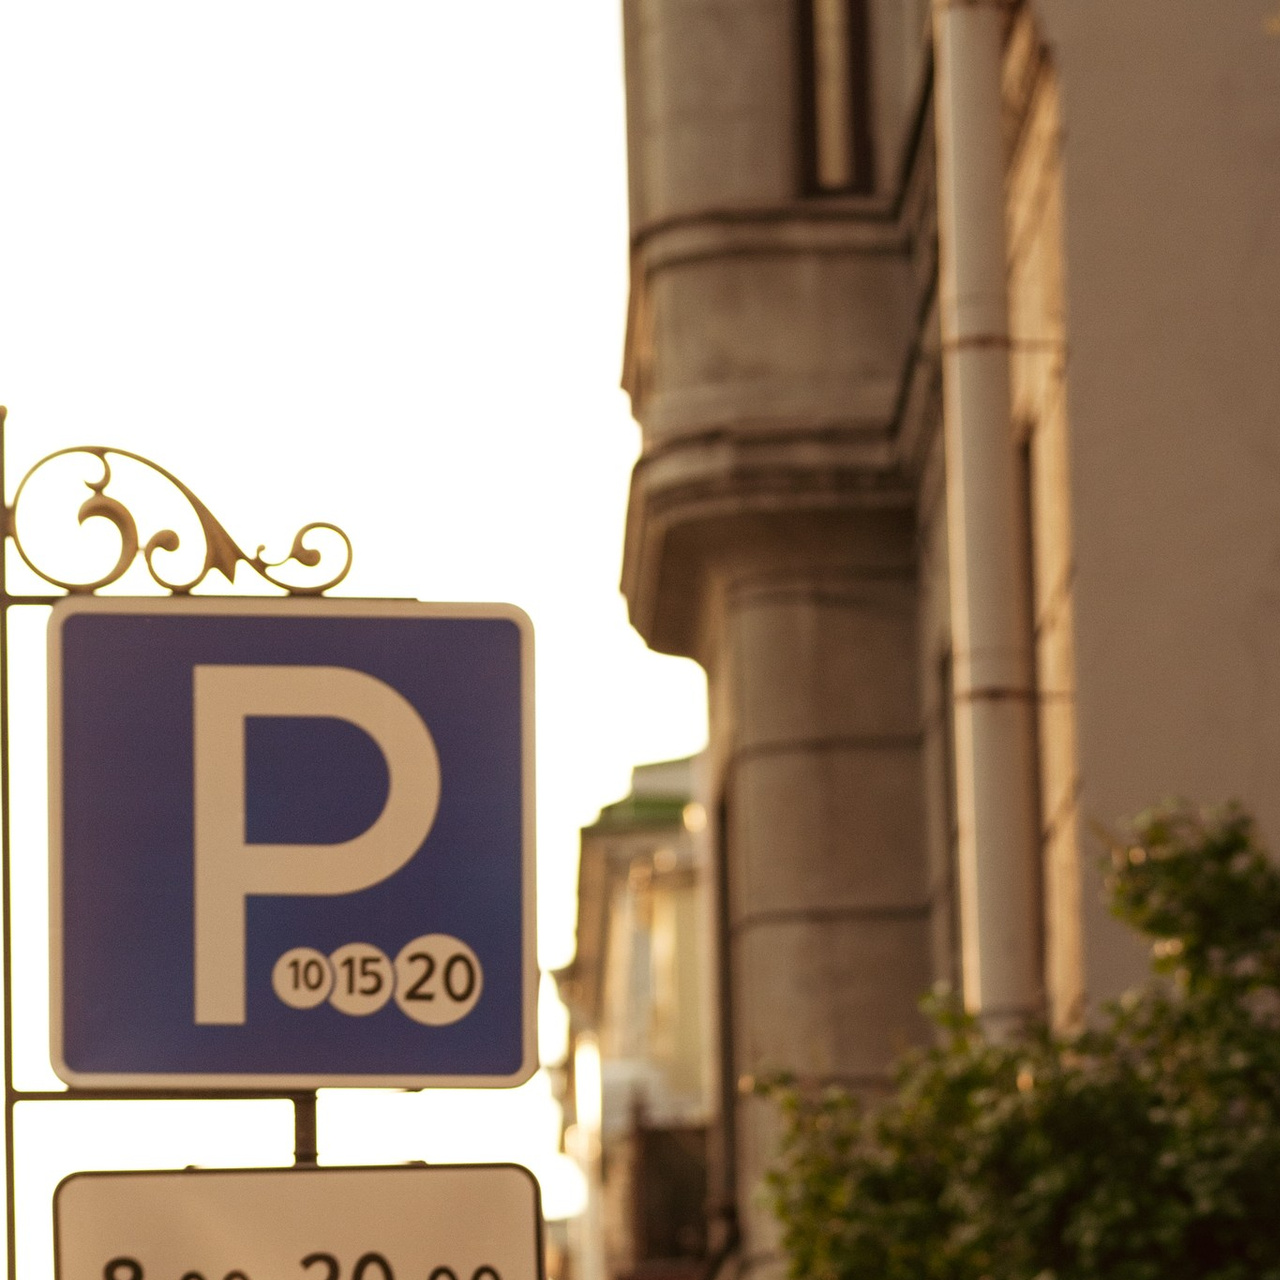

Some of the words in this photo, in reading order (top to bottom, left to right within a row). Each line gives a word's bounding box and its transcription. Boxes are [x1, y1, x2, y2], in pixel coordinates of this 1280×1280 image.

[193, 664, 441, 1026] P
[288, 958, 325, 992] 10
[340, 956, 384, 997] 15
[405, 951, 477, 1004] 20
